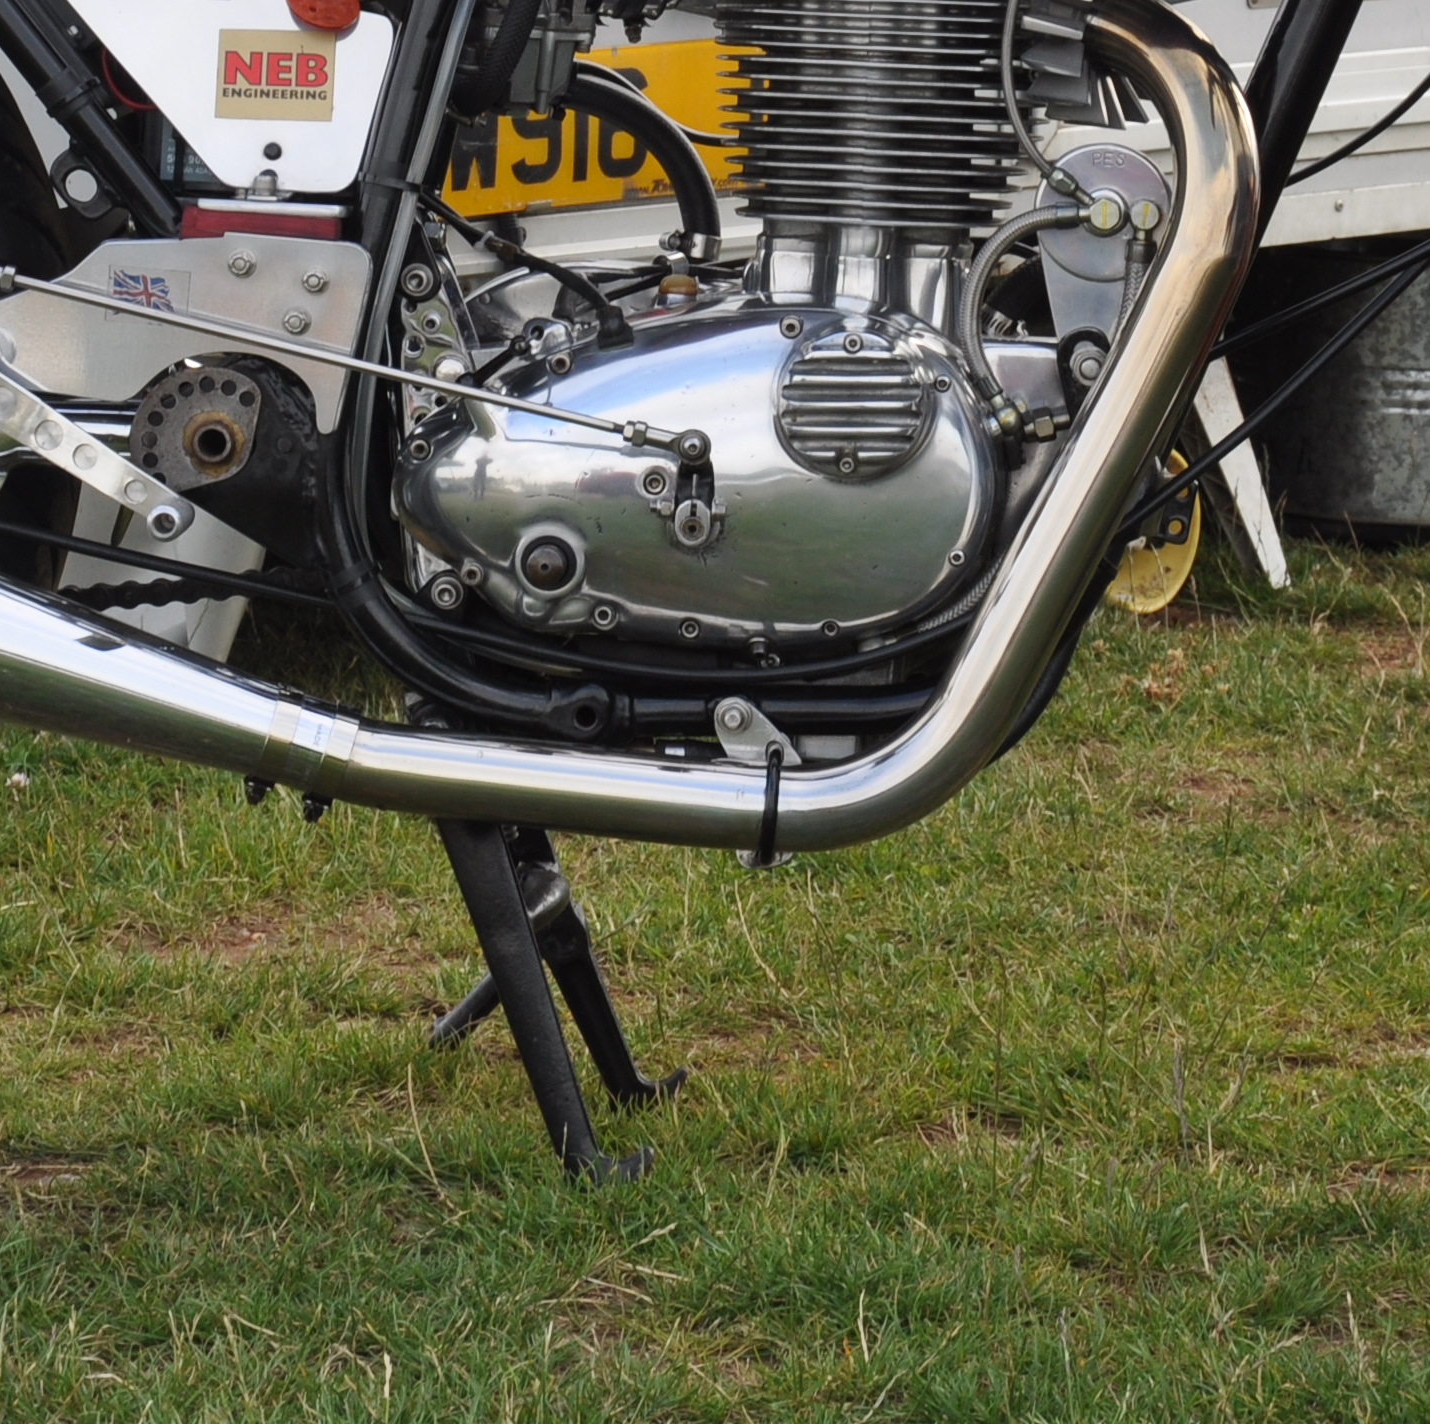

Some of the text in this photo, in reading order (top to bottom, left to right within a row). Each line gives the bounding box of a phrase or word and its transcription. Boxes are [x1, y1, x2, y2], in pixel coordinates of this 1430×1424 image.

[223, 51, 329, 88] NEB
[222, 87, 329, 102] ENGINEERING
[1091, 150, 1127, 168] PES
